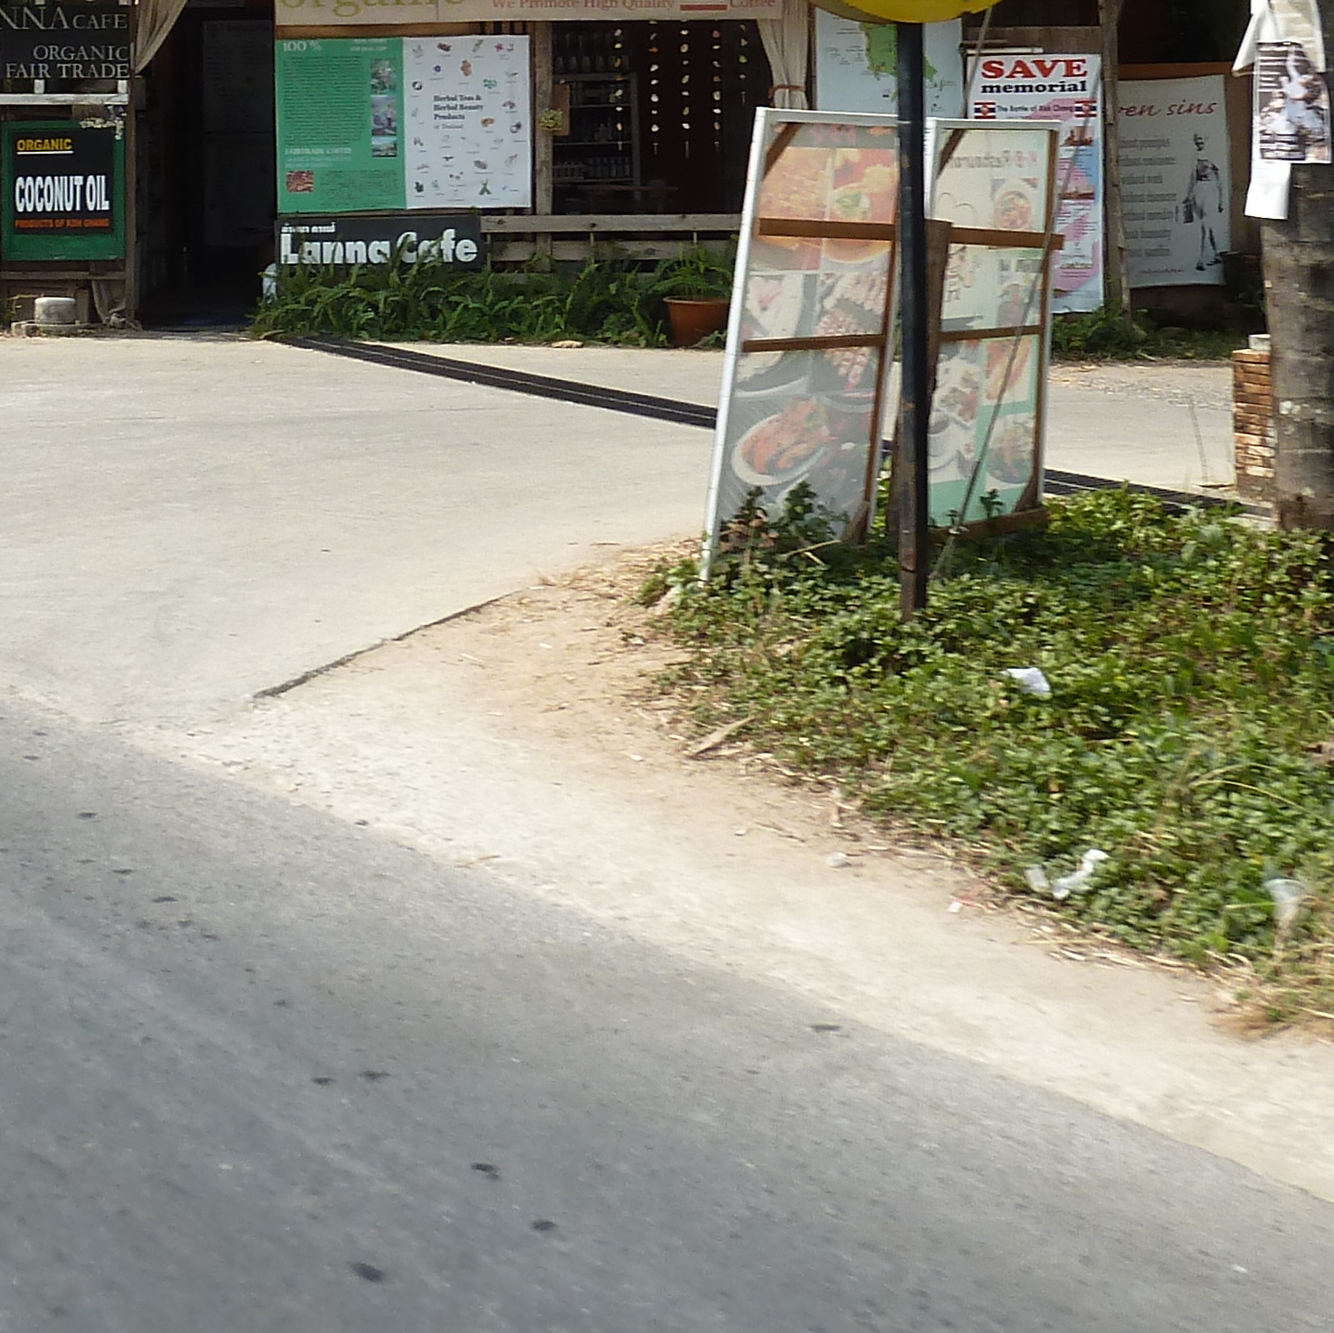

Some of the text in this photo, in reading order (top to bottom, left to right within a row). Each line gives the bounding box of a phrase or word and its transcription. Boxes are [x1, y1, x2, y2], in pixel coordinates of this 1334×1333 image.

[72, 14, 128, 30] CAFE
[33, 44, 129, 61] ORGANIC
[283, 41, 307, 52] 100
[6, 63, 130, 79] FAIR TRADE
[981, 58, 1088, 79] SAVE
[981, 80, 1088, 94] memorial
[1166, 99, 1218, 116] sins
[16, 138, 73, 151] ORGANIC
[15, 175, 110, 213] COCONUT OIL
[280, 229, 478, 265] Lanna Cafe
